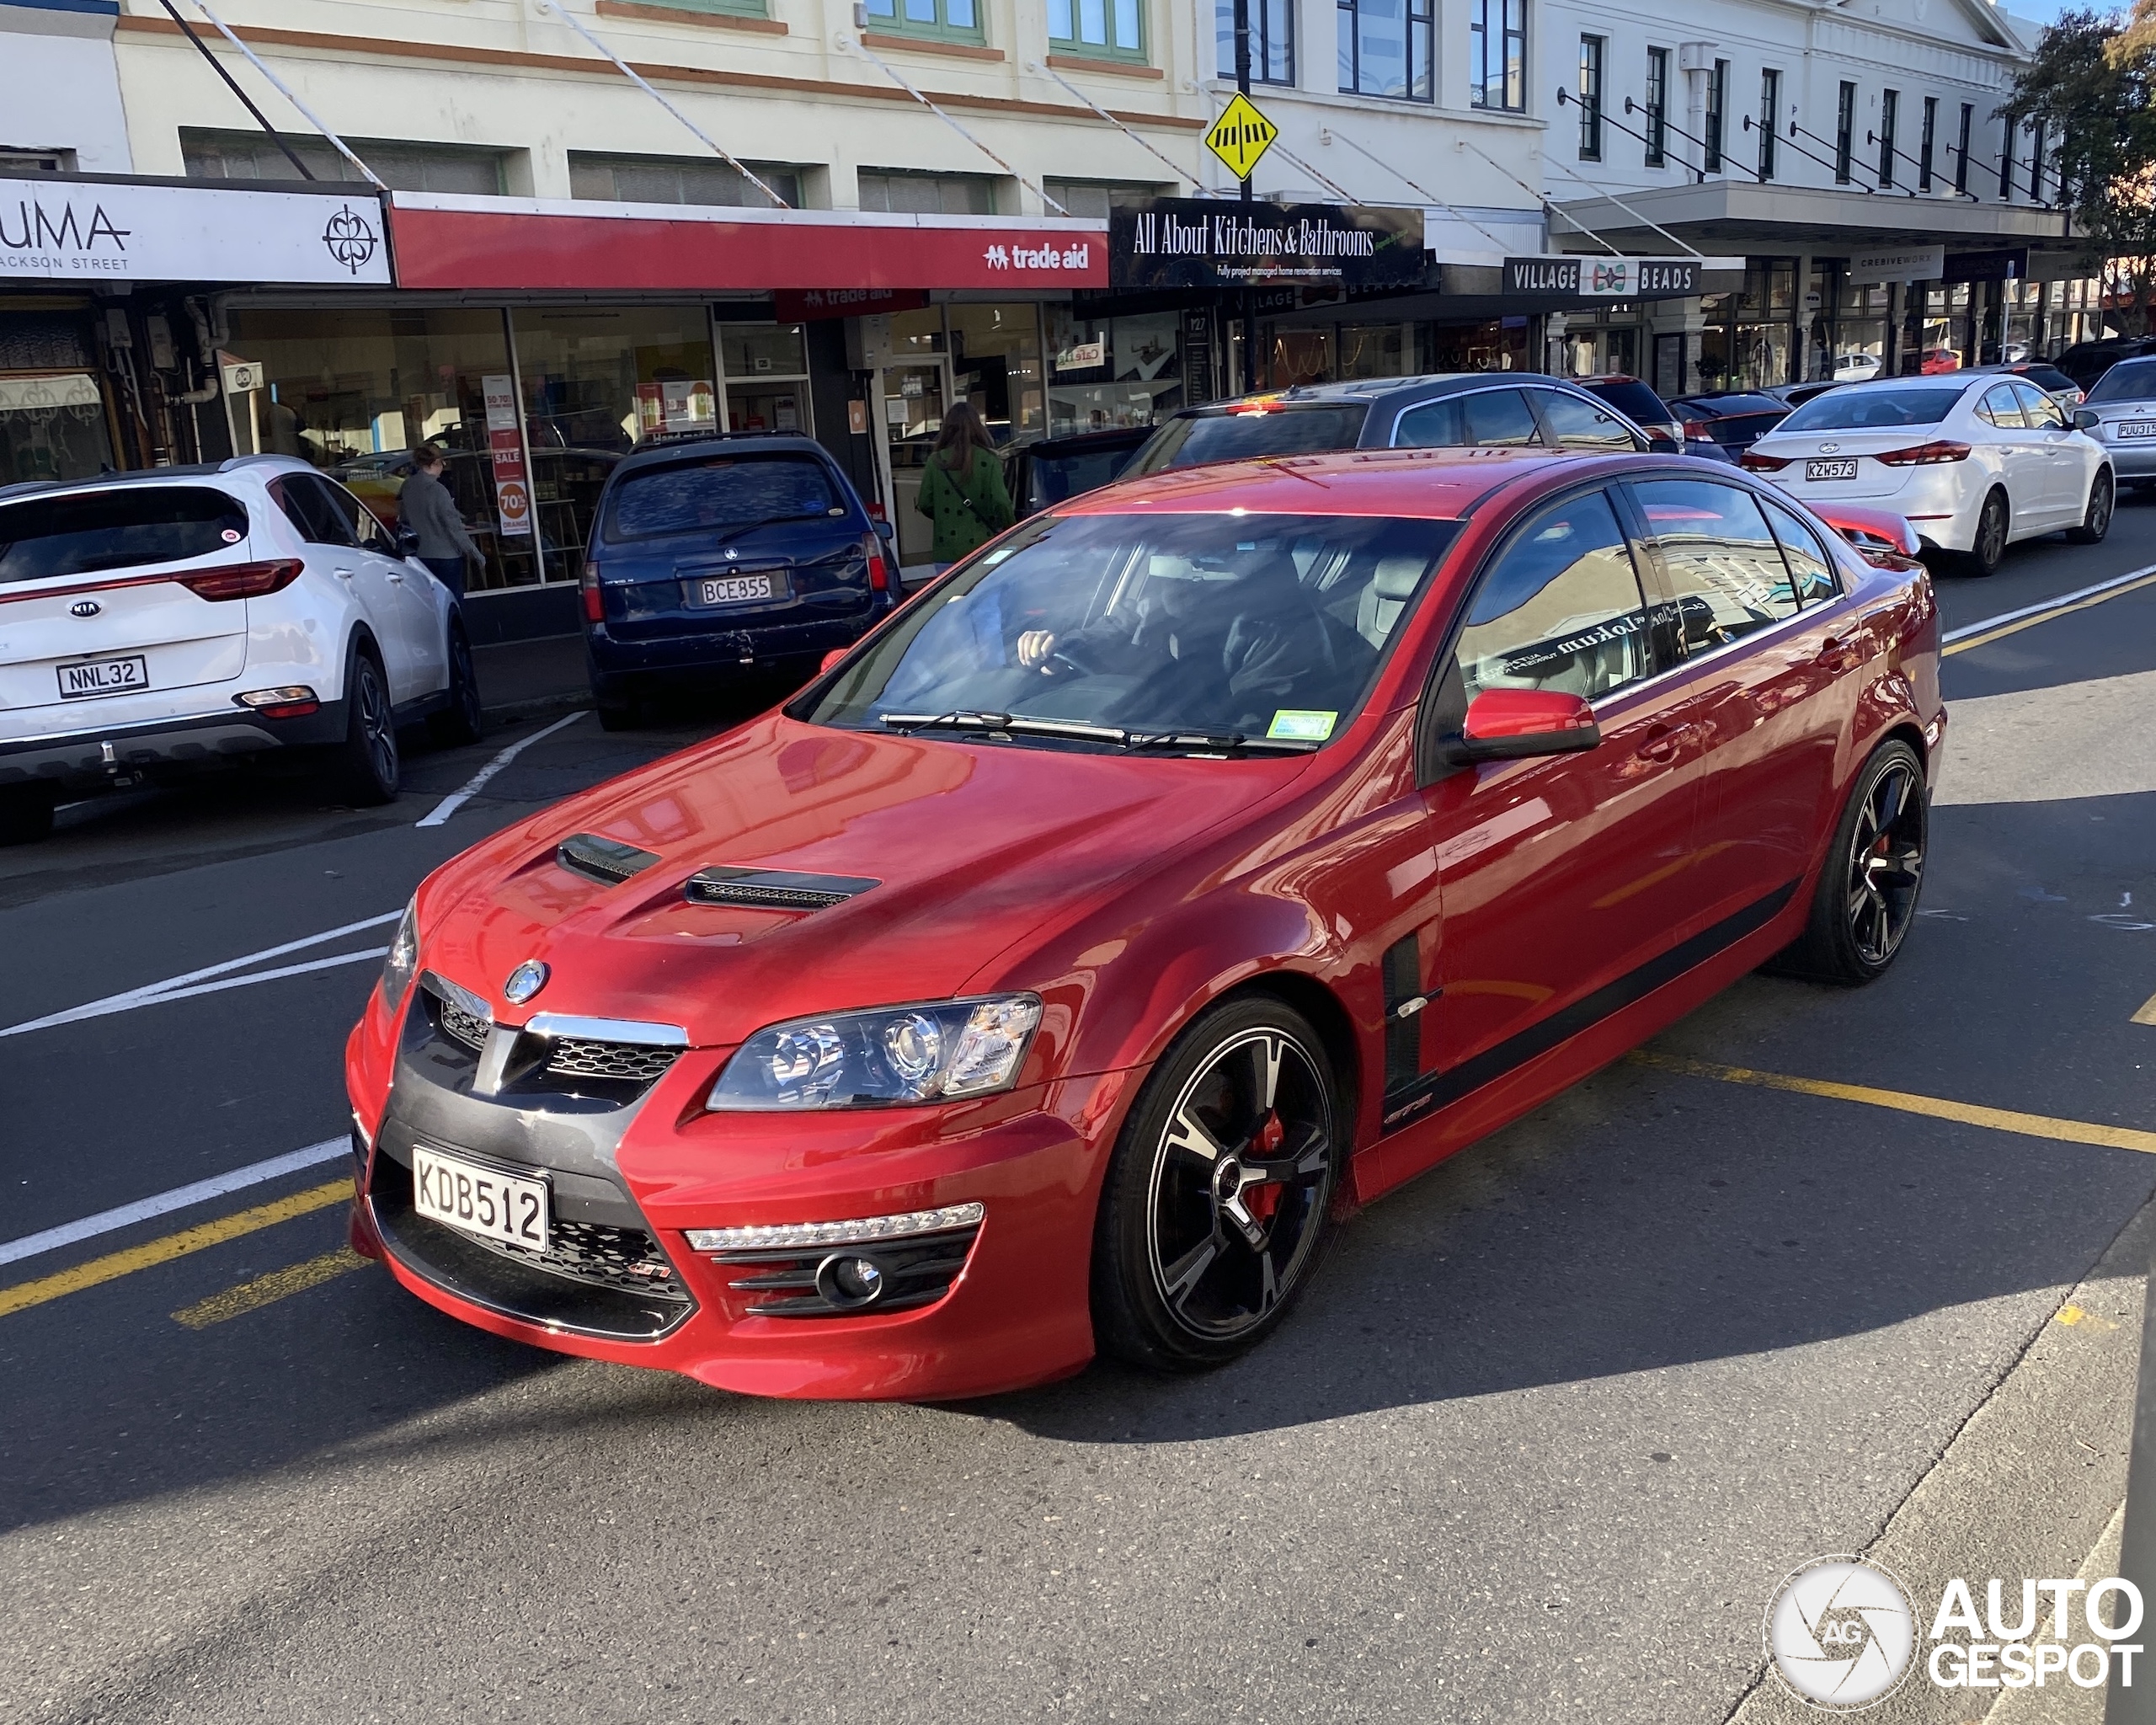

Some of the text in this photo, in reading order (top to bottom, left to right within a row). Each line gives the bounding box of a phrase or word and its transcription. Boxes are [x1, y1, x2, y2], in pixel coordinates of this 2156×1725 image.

[1134, 213, 1155, 254] All
[1161, 214, 1209, 254] About
[1214, 216, 1283, 255] Kitchens
[1284, 226, 1298, 254] &
[1299, 218, 1374, 256] Bathrooms
[72, 258, 128, 270] STREET
[1011, 243, 1088, 270] trade aid
[1217, 264, 1342, 279] Fully project managed home renovation services
[1514, 264, 1692, 290] VILLAGE BEADS
[1235, 289, 1292, 311] VLAGE
[901, 382, 922, 395] OPEN
[2120, 424, 2156, 435] PUU315
[495, 451, 520, 464] SALE
[500, 494, 526, 509] 70%
[704, 576, 770, 603] BCE855
[73, 603, 97, 614] KIA
[69, 663, 136, 690] NNL32
[418, 1159, 542, 1242] KDB512
